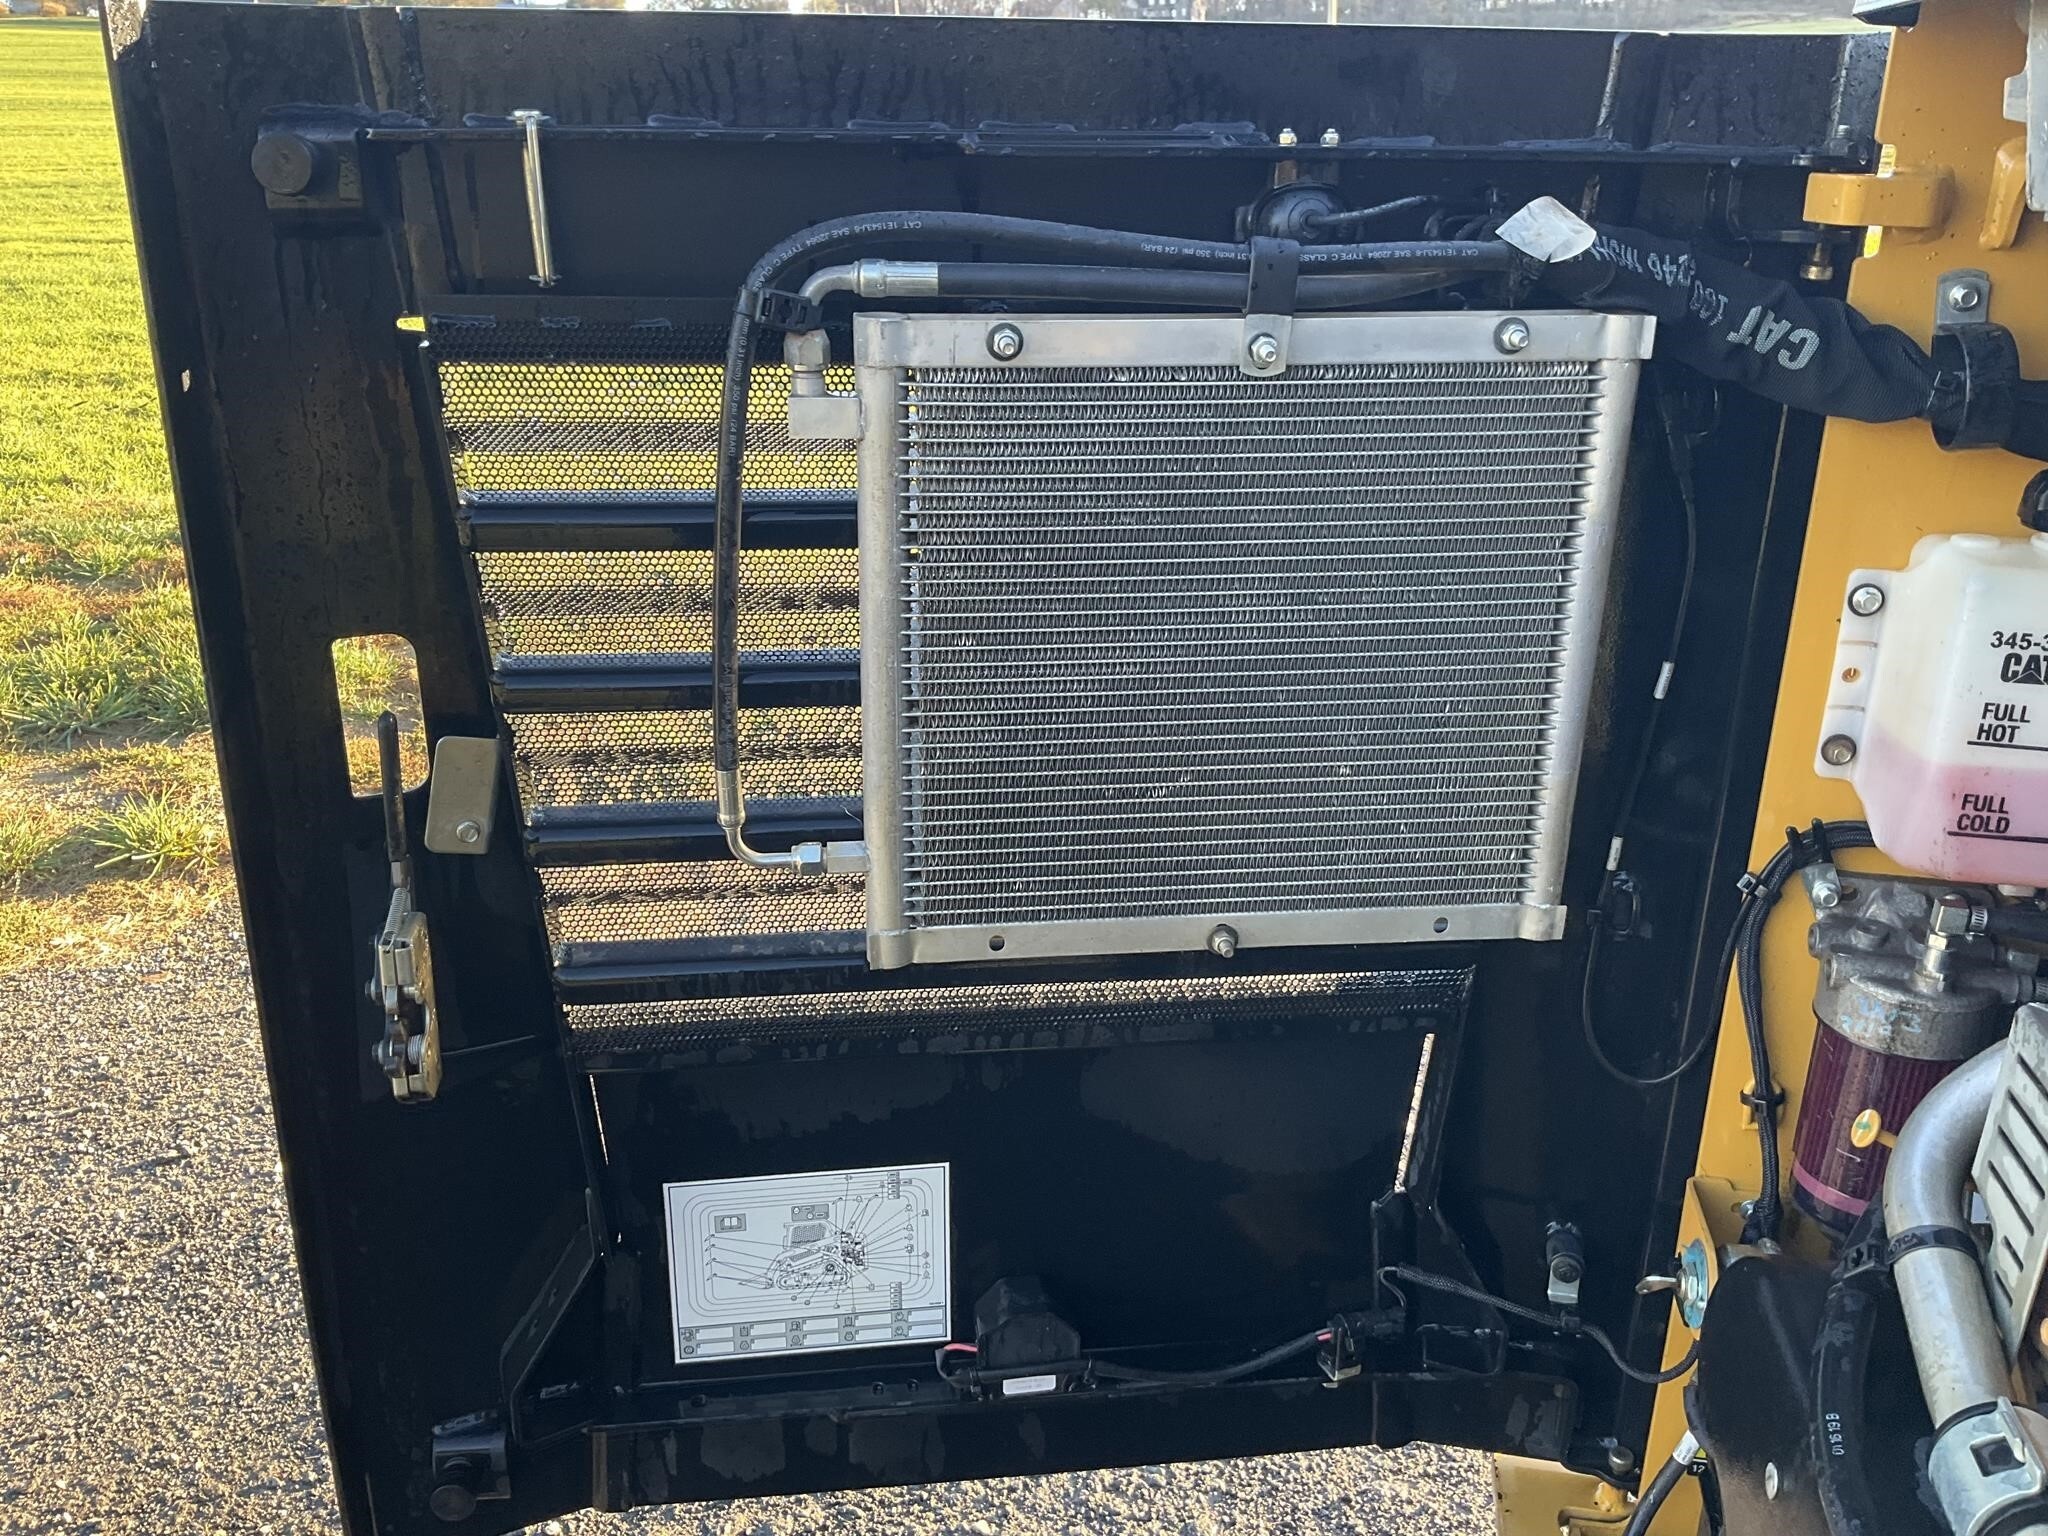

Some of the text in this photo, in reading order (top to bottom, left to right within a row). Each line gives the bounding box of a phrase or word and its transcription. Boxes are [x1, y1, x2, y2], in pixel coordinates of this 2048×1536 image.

[831, 227, 850, 238] SAE
[902, 221, 922, 230] CAT
[780, 244, 804, 261] TYPE
[1196, 249, 1211, 258] 350
[1340, 252, 1363, 261] TYPE
[1394, 250, 1412, 258] SAE
[1461, 248, 1479, 257] CAT
[1726, 305, 1821, 371] CAT
[2000, 653, 2048, 685] CA
[1981, 702, 2030, 723] FULL
[1976, 723, 2020, 743] HOT
[1961, 793, 2009, 814] FULL
[1957, 814, 2010, 834] COLD
